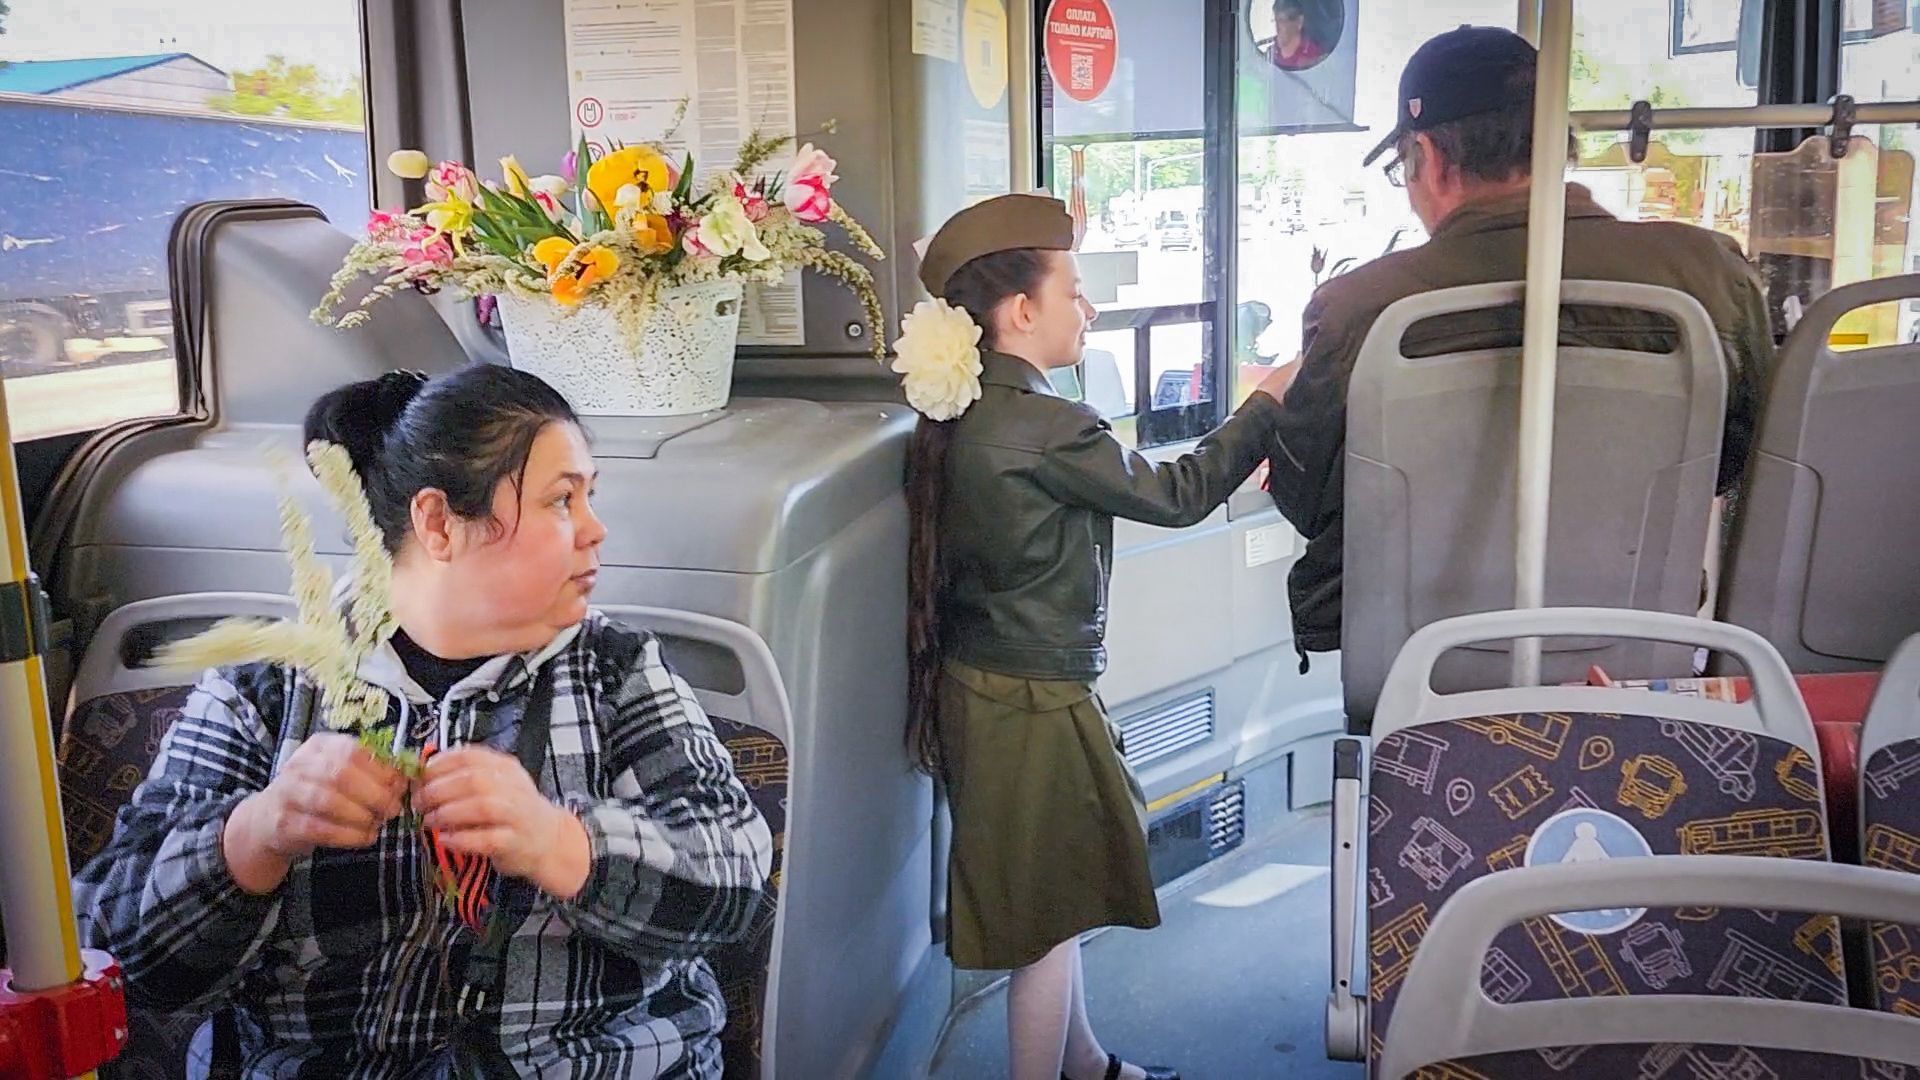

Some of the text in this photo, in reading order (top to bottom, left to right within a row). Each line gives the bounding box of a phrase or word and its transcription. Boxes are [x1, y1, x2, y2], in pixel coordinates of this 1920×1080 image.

[1065, 8, 1097, 22] ОПЛАТА
[1050, 21, 1113, 40] ТОЛЬКО КАРТОЙ
